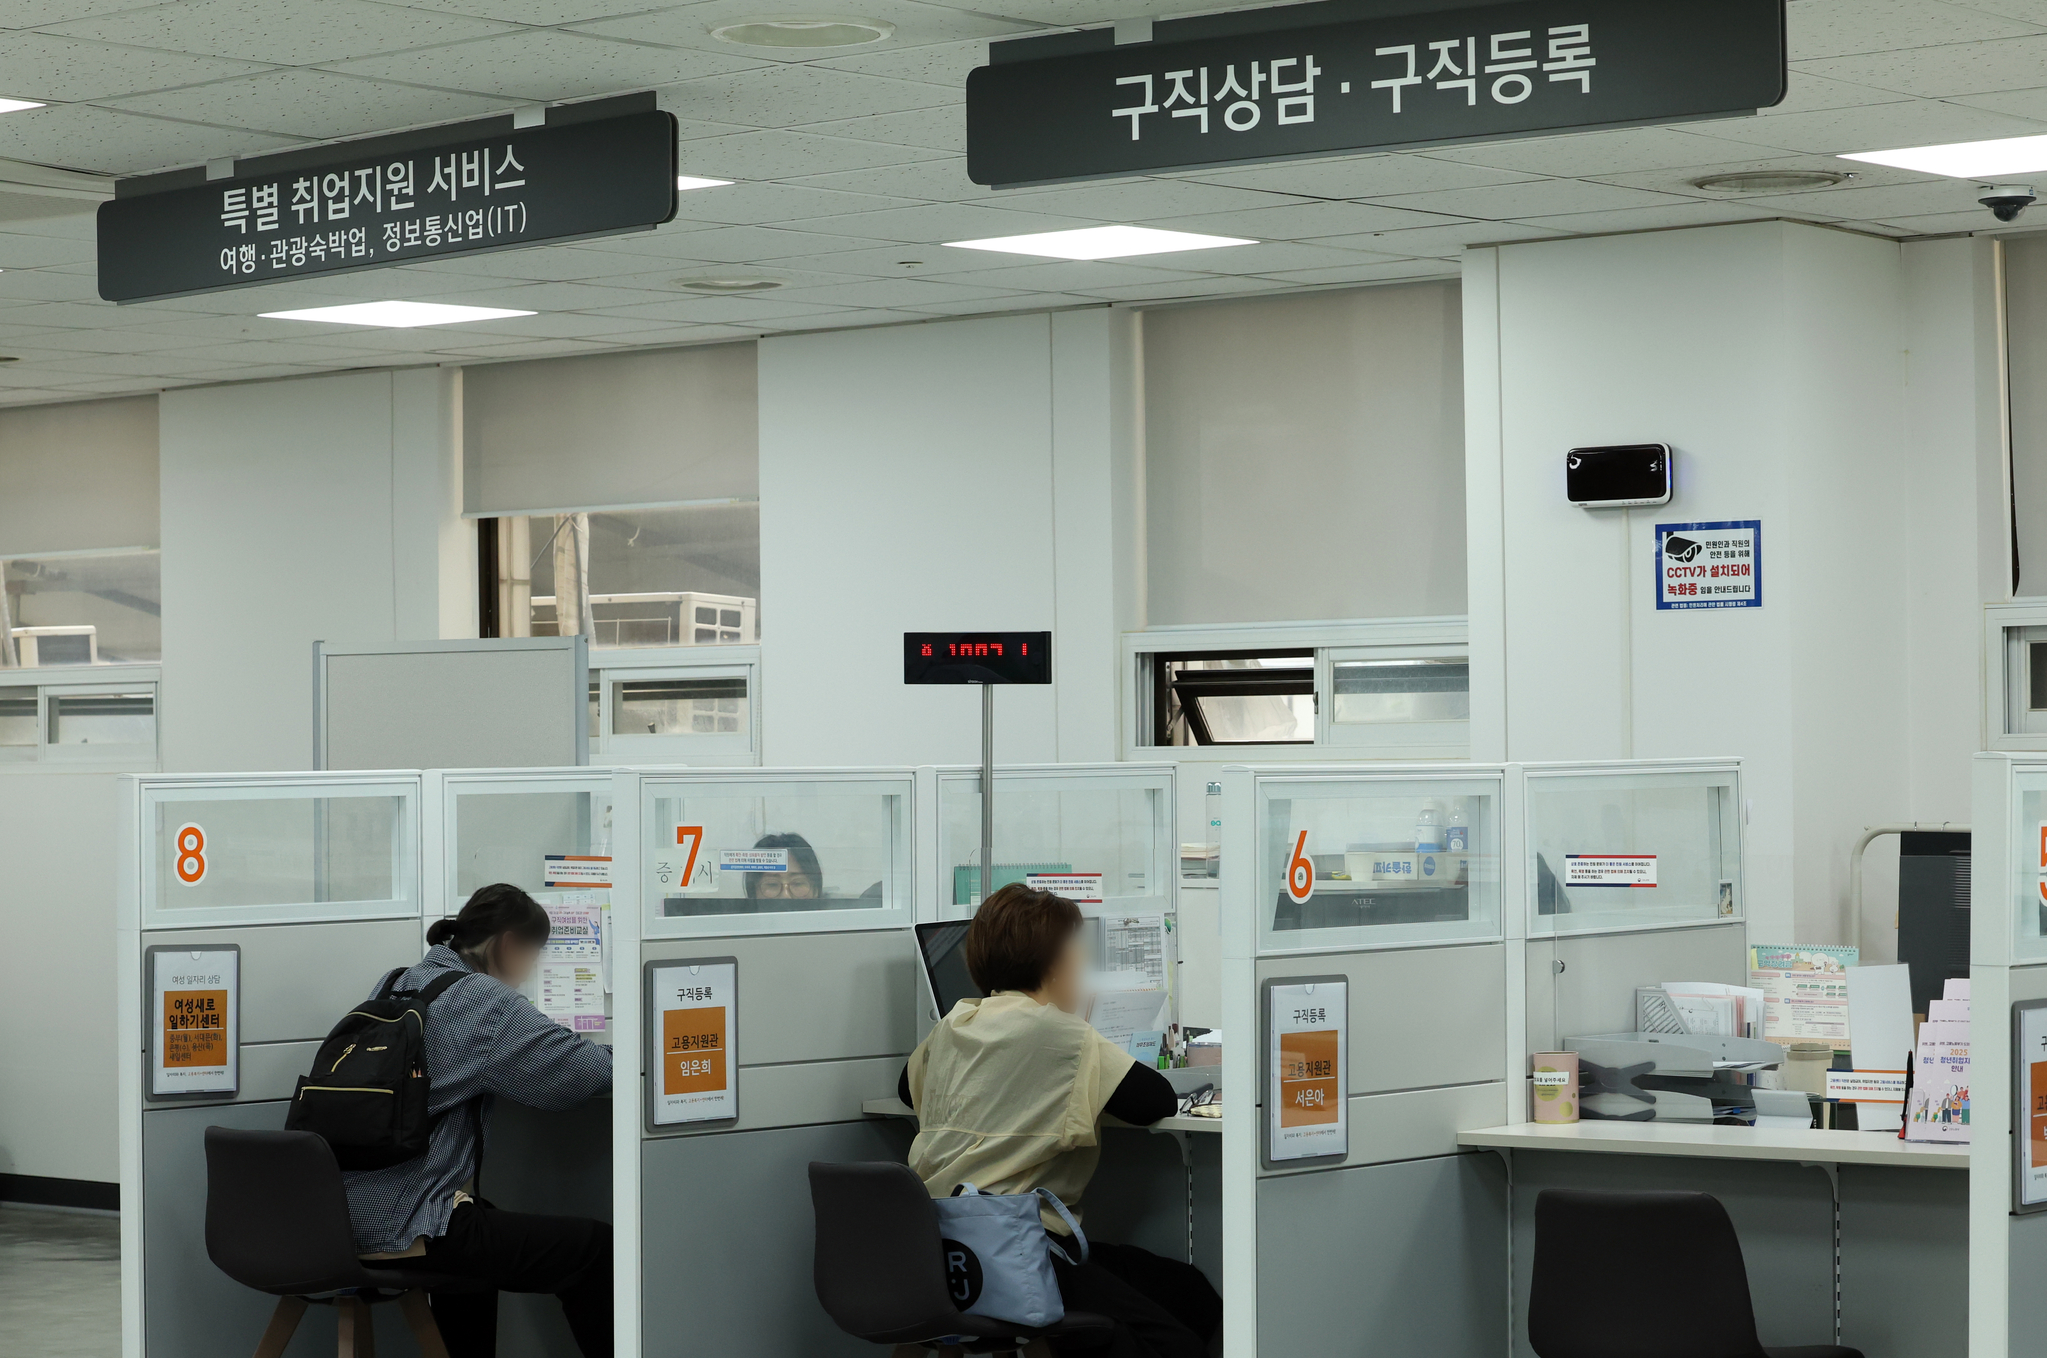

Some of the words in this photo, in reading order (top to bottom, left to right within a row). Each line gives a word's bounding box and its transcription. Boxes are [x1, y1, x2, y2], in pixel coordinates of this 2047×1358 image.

[1111, 55, 1322, 141] 구직상담
[1371, 23, 1597, 114] 구직등록
[220, 183, 279, 234] 특별
[291, 161, 415, 224] 취업지원
[427, 145, 526, 201] 서비스
[382, 201, 526, 253] 정보통신업(IT)
[1705, 540, 1730, 550] 민원인과
[1731, 540, 1750, 548] 직원의
[1710, 551, 1722, 560] 안전
[1724, 550, 1736, 559] 등을
[1738, 550, 1750, 558] 위해
[1667, 565, 1707, 578] CCTV가
[1710, 564, 1750, 578] 설치되어
[1667, 583, 1698, 596] 녹화중
[1700, 586, 1712, 594] 임을
[1714, 585, 1751, 594] 안내드립니다
[177, 827, 205, 882] 8
[677, 826, 702, 887] 7
[1289, 830, 1312, 898] 6
[551, 926, 588, 935] 취업준비교실
[172, 976, 185, 984] 여성
[186, 975, 206, 984] 일자리
[207, 975, 220, 984] 상담
[677, 986, 712, 1002] 구직등록
[174, 998, 216, 1014] 여성새로
[169, 1014, 220, 1029] 일하기센터
[1293, 1008, 1326, 1024] 구직등록
[672, 1033, 718, 1050] 고용지원관
[680, 1059, 712, 1077] 임은희
[1288, 1060, 1331, 1078] 고용지원관
[1295, 1088, 1325, 1108] 서은아
